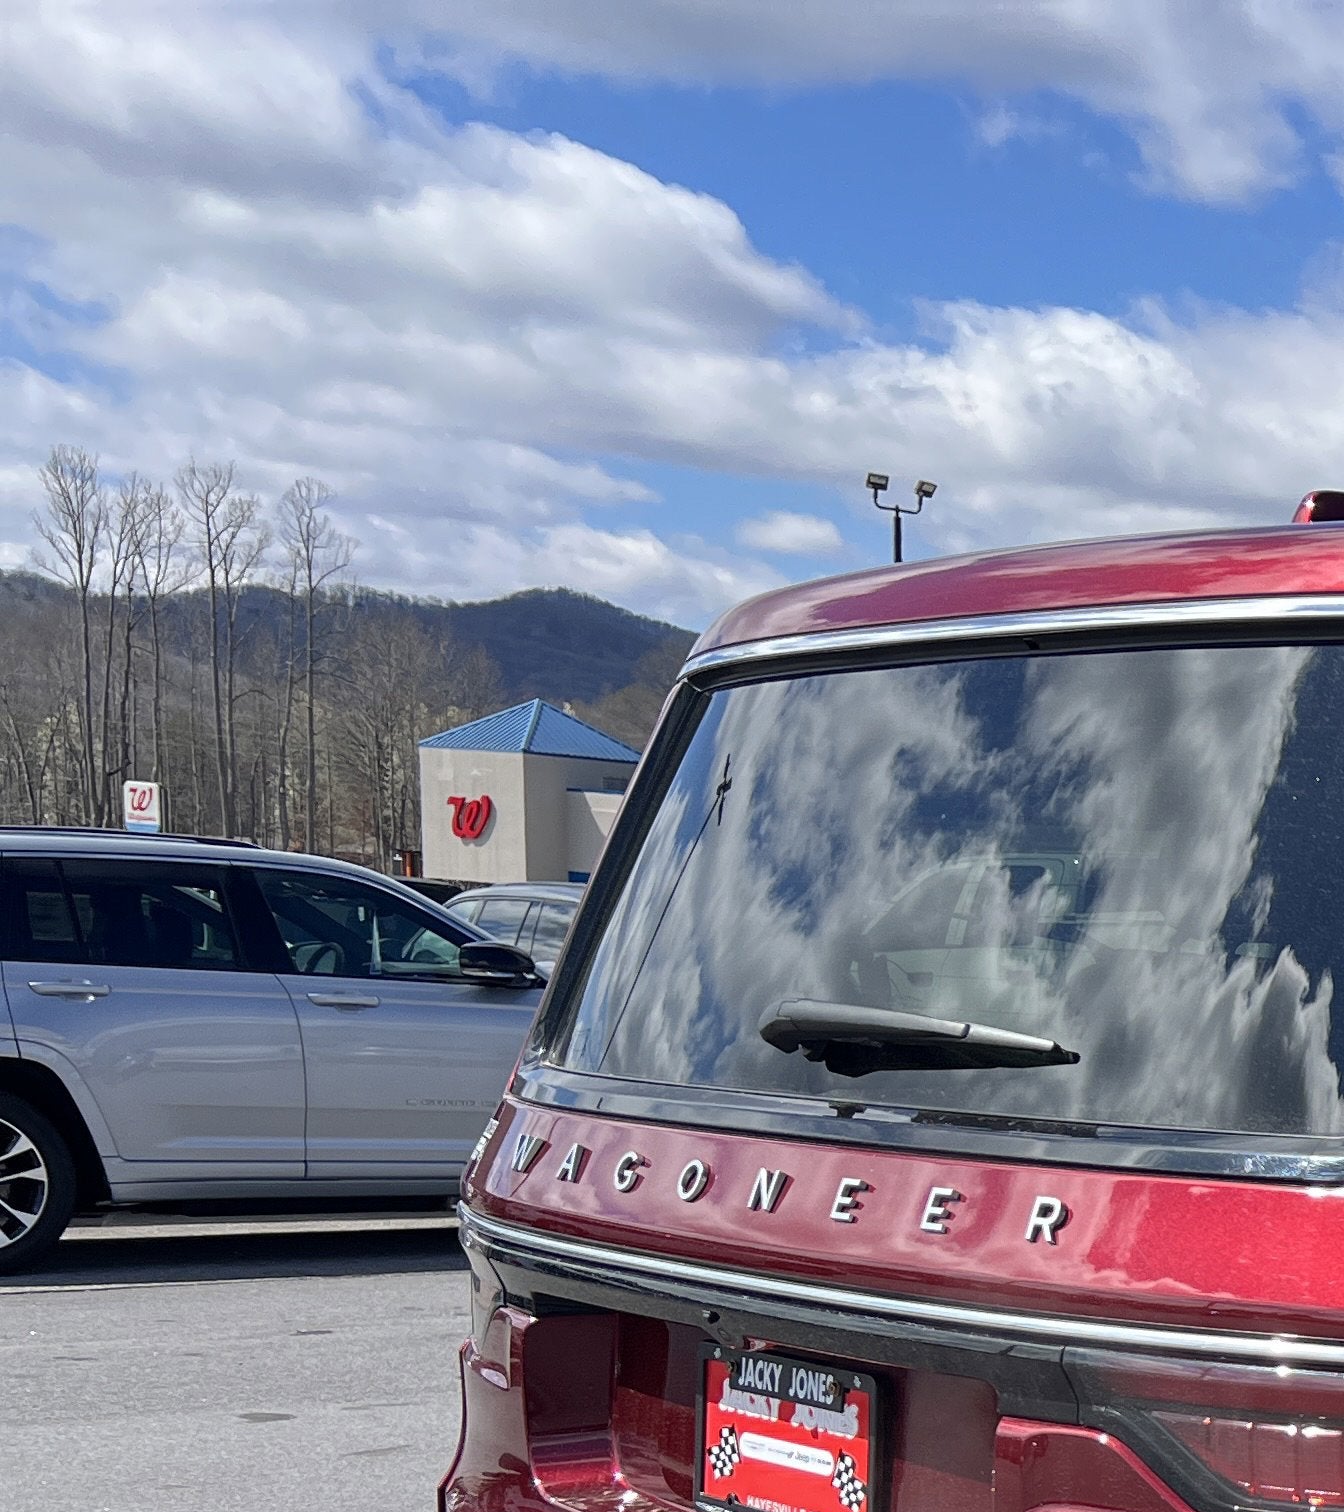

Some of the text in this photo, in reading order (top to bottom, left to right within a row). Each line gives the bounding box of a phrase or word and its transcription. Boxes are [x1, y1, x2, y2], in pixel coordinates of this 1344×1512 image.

[447, 795, 491, 839] W
[511, 1133, 1069, 1245] WAGONEER
[737, 1356, 834, 1405] JACKY JONES
